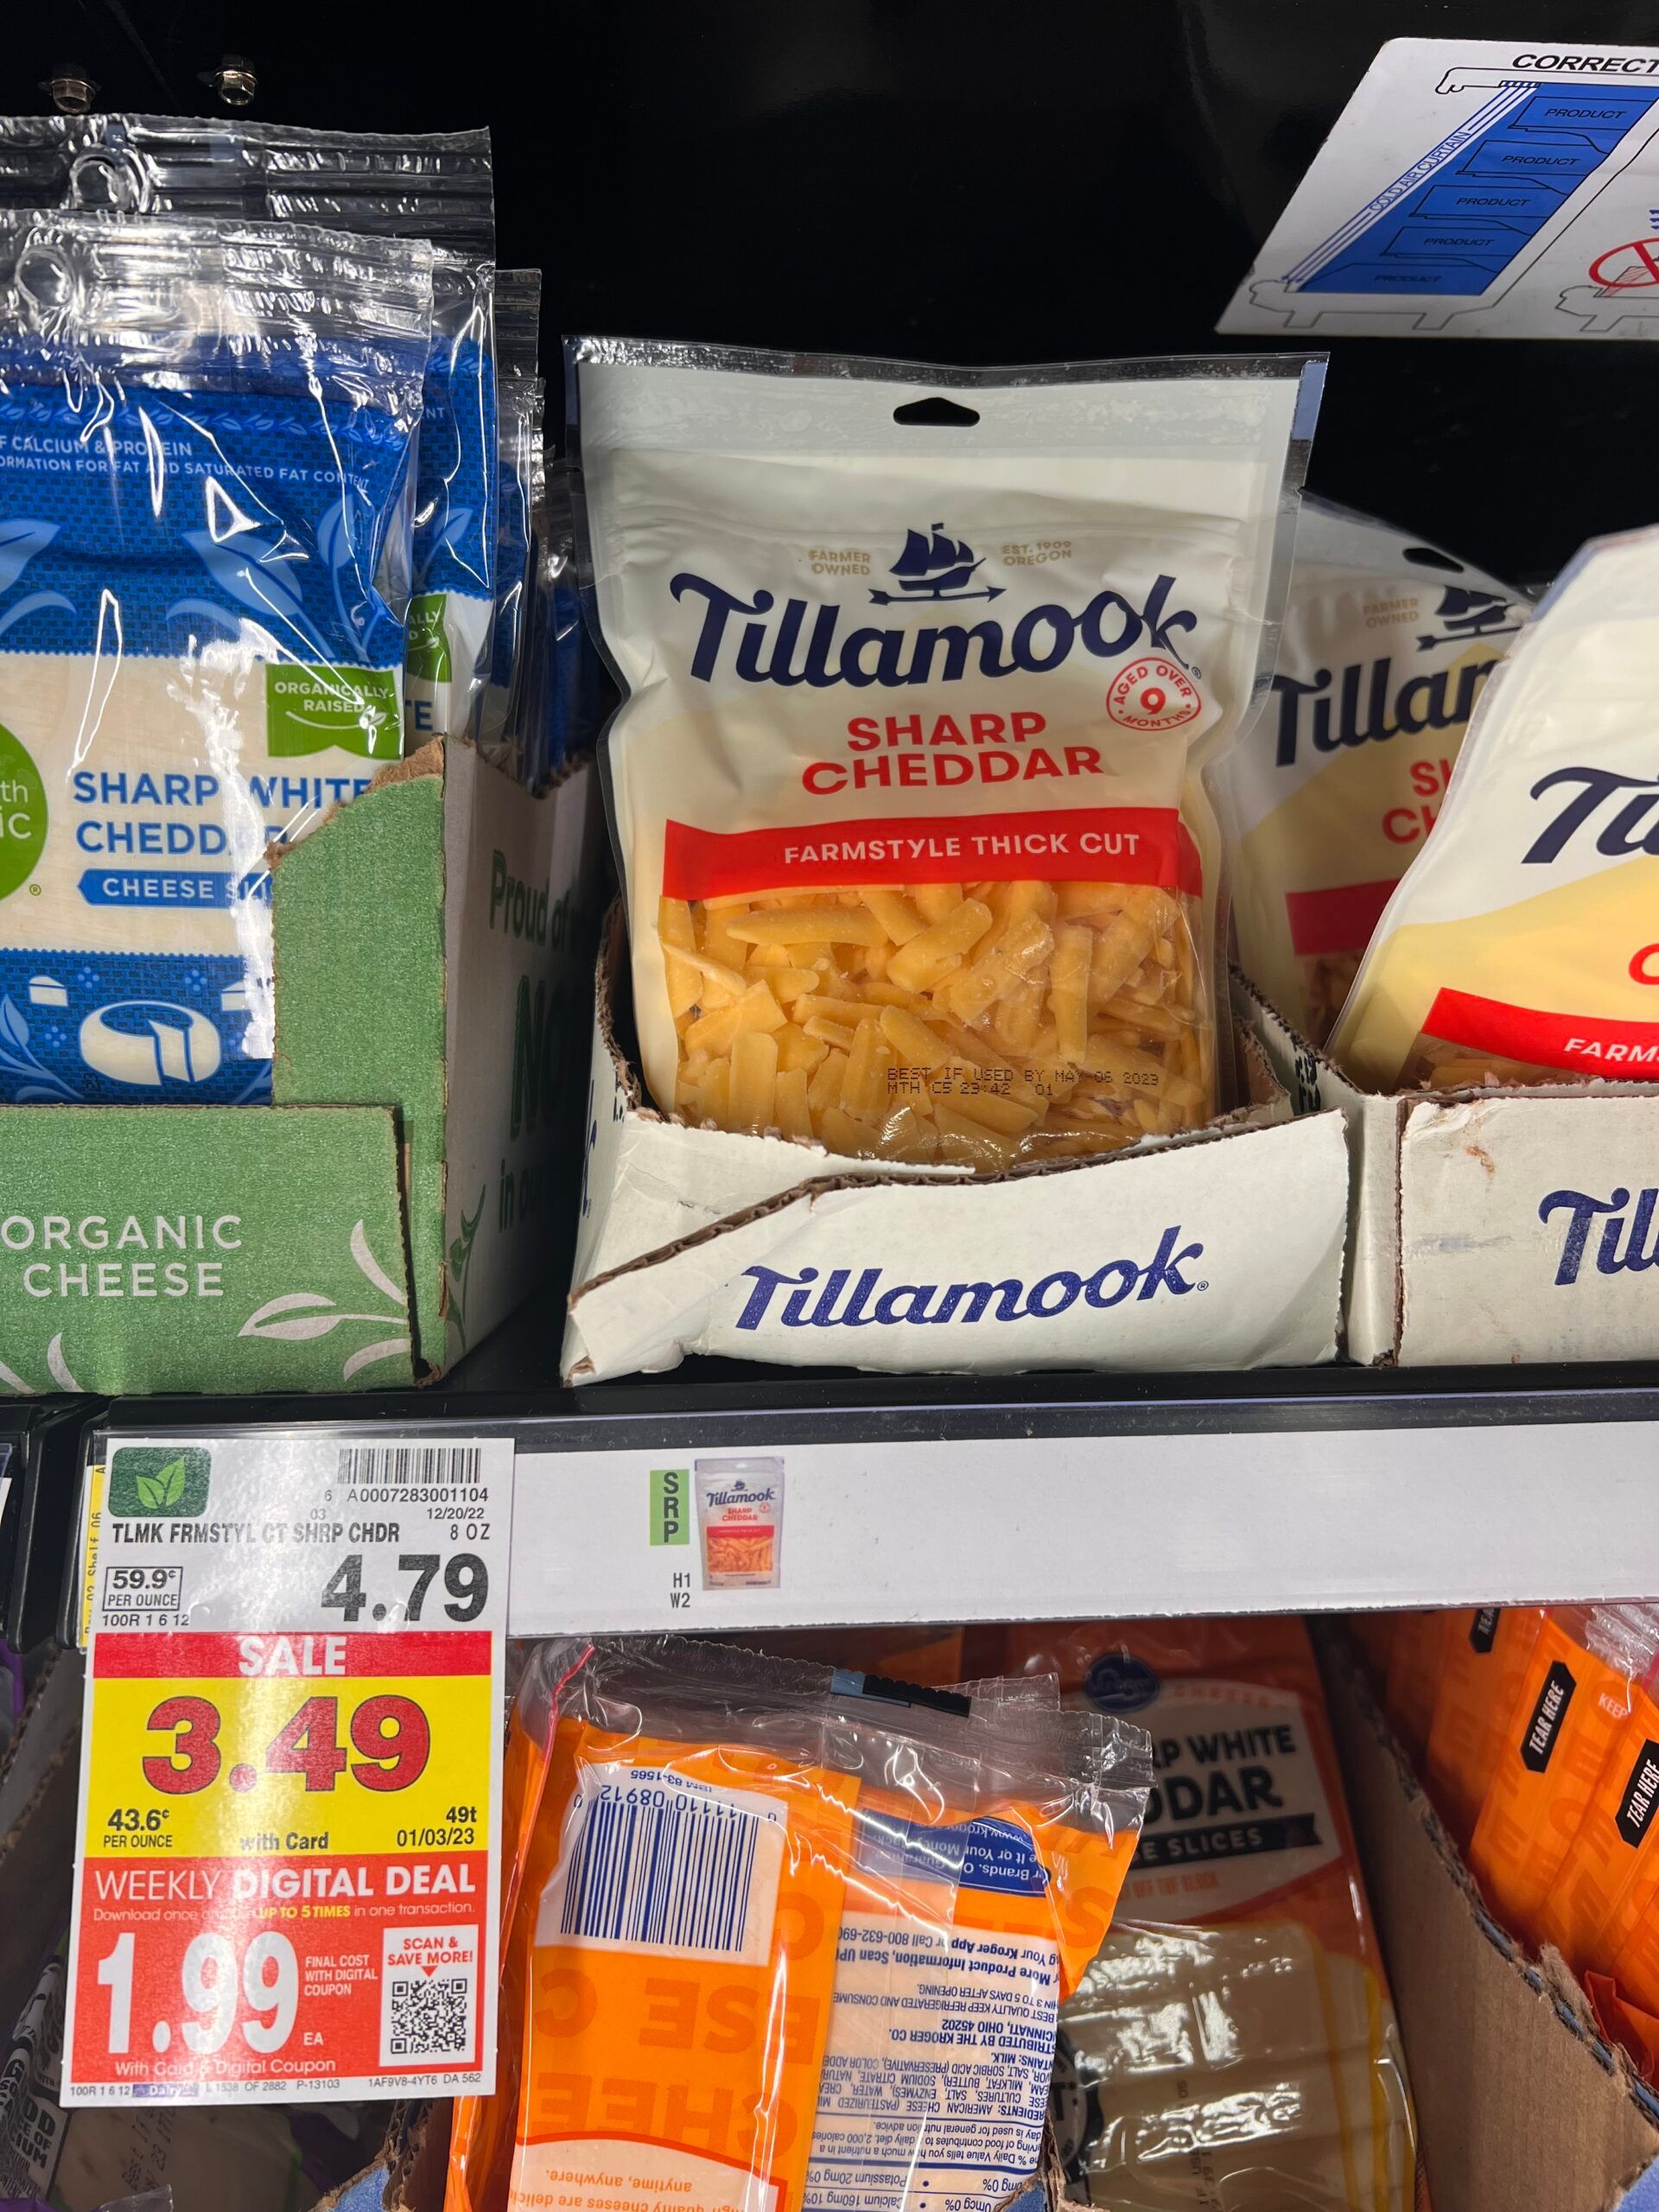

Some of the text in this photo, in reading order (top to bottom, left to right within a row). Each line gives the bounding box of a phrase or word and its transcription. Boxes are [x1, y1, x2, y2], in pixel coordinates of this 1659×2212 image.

[1544, 108, 1626, 120] PRODUCT
[1501, 155, 1580, 166] PRODUCT
[1370, 131, 1470, 213] COLD AIR CURTAIN
[1456, 197, 1531, 207] PRODUCT
[1424, 238, 1495, 247] PRODUCT
[1374, 275, 1442, 283] PRODUCT
[12, 435, 89, 454] CALCIUM
[115, 441, 193, 456] PROEIN
[76, 460, 107, 473] FOR
[115, 462, 140, 474] FAT
[184, 462, 274, 479] SATURATED
[279, 467, 308, 480] FAT
[314, 470, 369, 489] CONTENT
[808, 549, 871, 563] FARMER
[1001, 539, 1073, 556] EST. 1909
[1002, 547, 1073, 567] OREGON
[811, 563, 871, 576] OWNED
[1366, 610, 1419, 629] OWNED
[670, 573, 1197, 688] Tillamook
[274, 681, 389, 700] ORGANICALLY
[1113, 664, 1192, 705] AGED OVER
[303, 697, 365, 714] RAISED
[1141, 688, 1166, 715] 9
[1122, 710, 1191, 727] MONTHS
[846, 711, 1046, 752] SHARP
[801, 746, 1104, 795] CHEDDAR
[73, 771, 219, 807] SHARP
[785, 831, 1140, 864] FARMSTYLE THICK CUT
[102, 878, 214, 899] CHEESE
[489, 848, 550, 947] Proud
[887, 1067, 931, 1080] BEST
[944, 1067, 963, 1080] IF
[974, 1068, 1014, 1081] USED
[1024, 1070, 1045, 1082] BY
[1055, 1070, 1085, 1083] MAY
[1122, 1071, 1160, 1086] 2023
[887, 1082, 920, 1094] MTH
[931, 1082, 952, 1094] C5
[1035, 1084, 1052, 1096] 01
[1, 1215, 242, 1250] ORGANIC
[22, 1262, 224, 1297] CHEESE
[738, 1225, 1204, 1331] Tillamook
[324, 1488, 489, 1503] 6 A0007283001104
[707, 1488, 775, 1507] Tillamook
[427, 1508, 485, 1520] 12/20/22
[112, 1522, 491, 1543] TLMK FRMSTYL CT SHRP CHDR 8 OZ
[321, 1553, 489, 1622] 4.79
[672, 1573, 690, 1588] H1
[108, 1594, 178, 1606] PER OUNCE
[671, 1592, 690, 1608] W2
[102, 1614, 189, 1626] 100R 1 6 12
[238, 1636, 346, 1676] SALE
[1598, 1692, 1629, 1719] KEEP
[1529, 1680, 1565, 1755] TEAR HERE
[142, 1694, 431, 1794] 3.49
[1185, 1724, 1296, 1764] WHITE
[631, 1770, 683, 1789] 83-1565
[601, 1784, 665, 1808] 08912
[1627, 1791, 1650, 1828] TEAR
[103, 1827, 474, 1850] PER OUNCE with Card 01/03/23
[1166, 1827, 1264, 1858] SLICES
[978, 1863, 1030, 1880] Brands.
[95, 1864, 476, 1900] WEEKLY DIGITAL DEAL
[93, 1908, 161, 1922] Download
[163, 1910, 198, 1921] once
[260, 1907, 277, 1919] UP
[280, 1906, 298, 1919] TO
[302, 1906, 311, 1917] 5
[313, 1905, 351, 1917] TIMES
[354, 1904, 365, 1916] in
[370, 1905, 395, 1916] one
[398, 1902, 475, 1916] transaction.
[403, 1936, 458, 1950] SCAN &
[950, 1938, 975, 1954] App
[977, 1943, 1019, 1960] Kroger
[305, 1955, 370, 1967] FINAL COST
[387, 1950, 473, 1966] SAVE MORE!
[860, 1949, 1051, 1986] More Product Information, Scan
[305, 1968, 378, 1981] WITH DIGITAL
[97, 1930, 300, 2055] 1.99
[304, 1983, 351, 1997] COUPON
[902, 1997, 966, 2012] REFRIGERATED
[942, 2018, 1004, 2034] OHIO 45202
[303, 2032, 324, 2047] EA
[910, 2031, 954, 2044] KROGER
[115, 2062, 149, 2076] With
[216, 2060, 266, 2077] Digital
[270, 2059, 336, 2075] Coupon
[70, 2086, 96, 2096] 100R
[109, 2086, 115, 2095] 6
[119, 2086, 130, 2095] 12
[245, 2082, 260, 2092] OF
[263, 2081, 287, 2091] 2882
[296, 2079, 340, 2090] P-13103
[443, 2074, 459, 2083] DA
[462, 2073, 481, 2082] 562
[946, 2101, 993, 2115] AMERICAN
[545, 2169, 693, 2195] anytime, anywhere.
